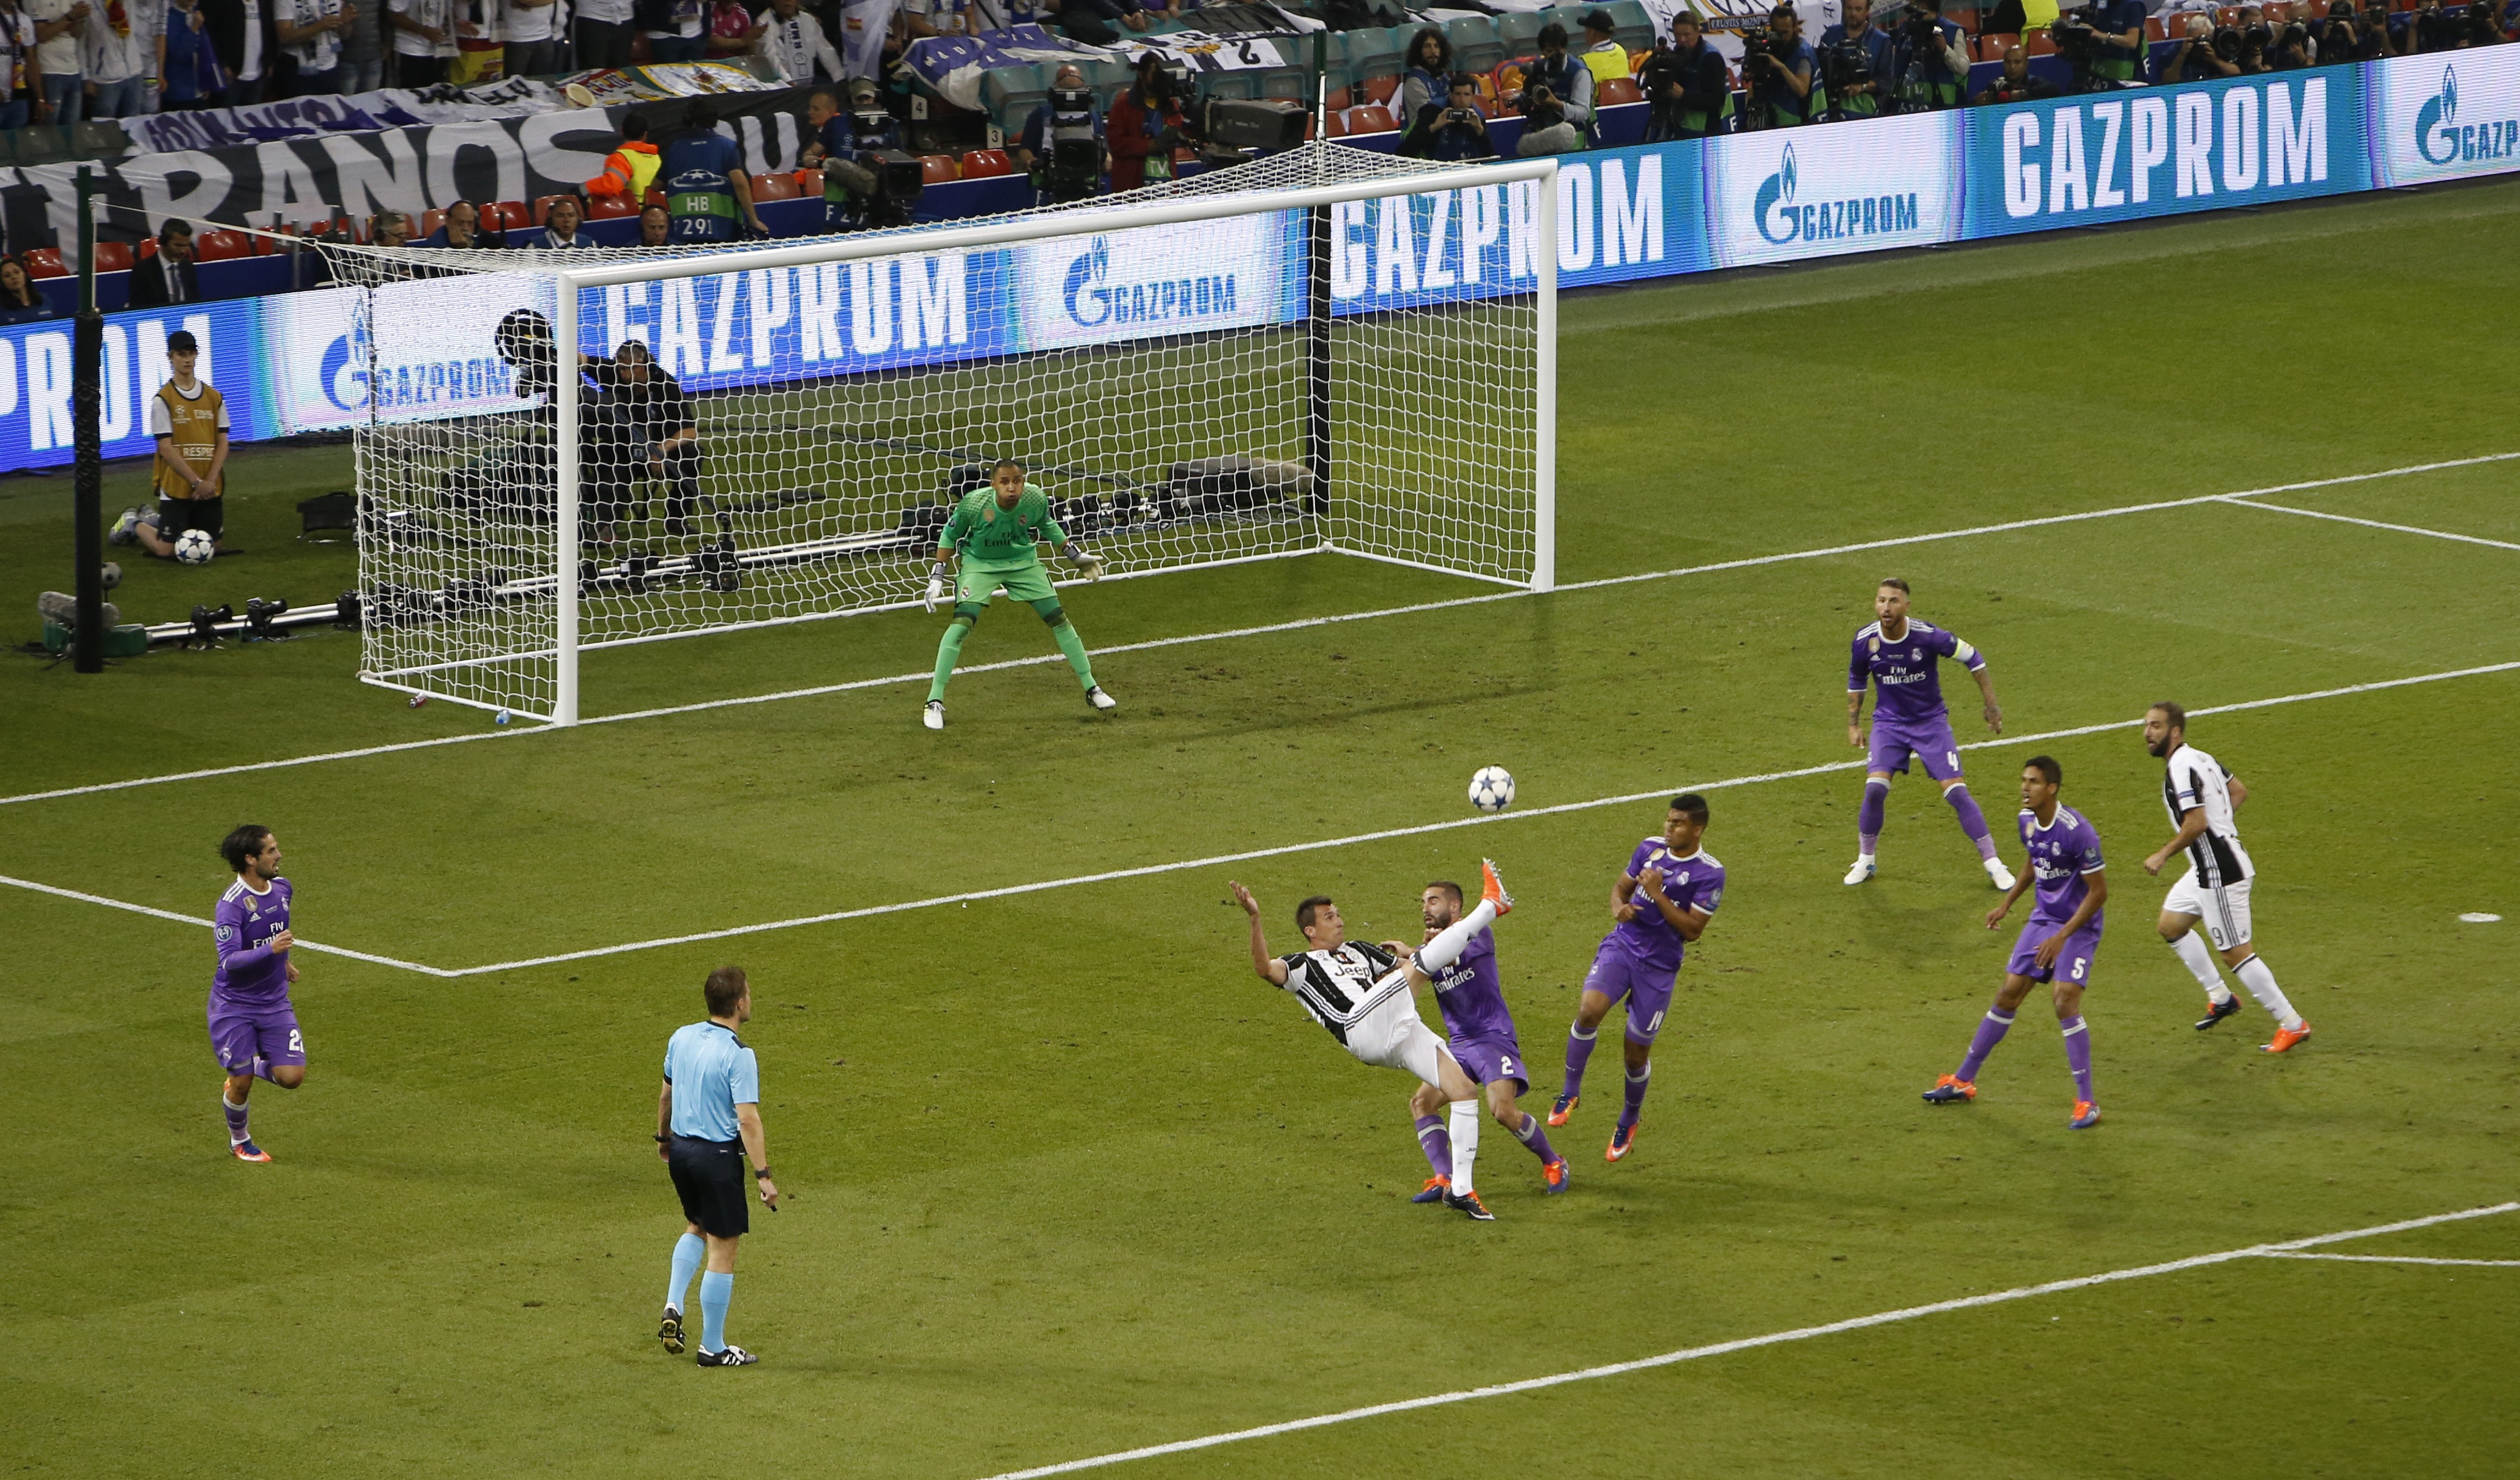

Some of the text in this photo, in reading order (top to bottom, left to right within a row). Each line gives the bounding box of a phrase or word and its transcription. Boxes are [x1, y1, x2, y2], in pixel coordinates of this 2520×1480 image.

[915, 101, 922, 114] 4
[991, 130, 998, 142] 3
[2462, 120, 2518, 161] GAZP
[2003, 76, 2328, 218] GAZPROM
[686, 196, 709, 212] HB
[1330, 154, 1664, 300] GAZPROM
[1802, 192, 1918, 242] GAZPROM
[1114, 274, 1237, 323] GAZPROM
[607, 252, 968, 381] GAZPROM
[376, 357, 510, 407] GAZPROM
[1891, 666, 1907, 675] Fly
[1947, 751, 1959, 771] 4
[270, 921, 284, 933] Fly
[2212, 927, 2225, 947] 9
[1335, 966, 1370, 978] Jeep
[2072, 958, 2086, 980] 5
[1434, 968, 1475, 993] Emirates
[1500, 1056, 1514, 1075] 2
